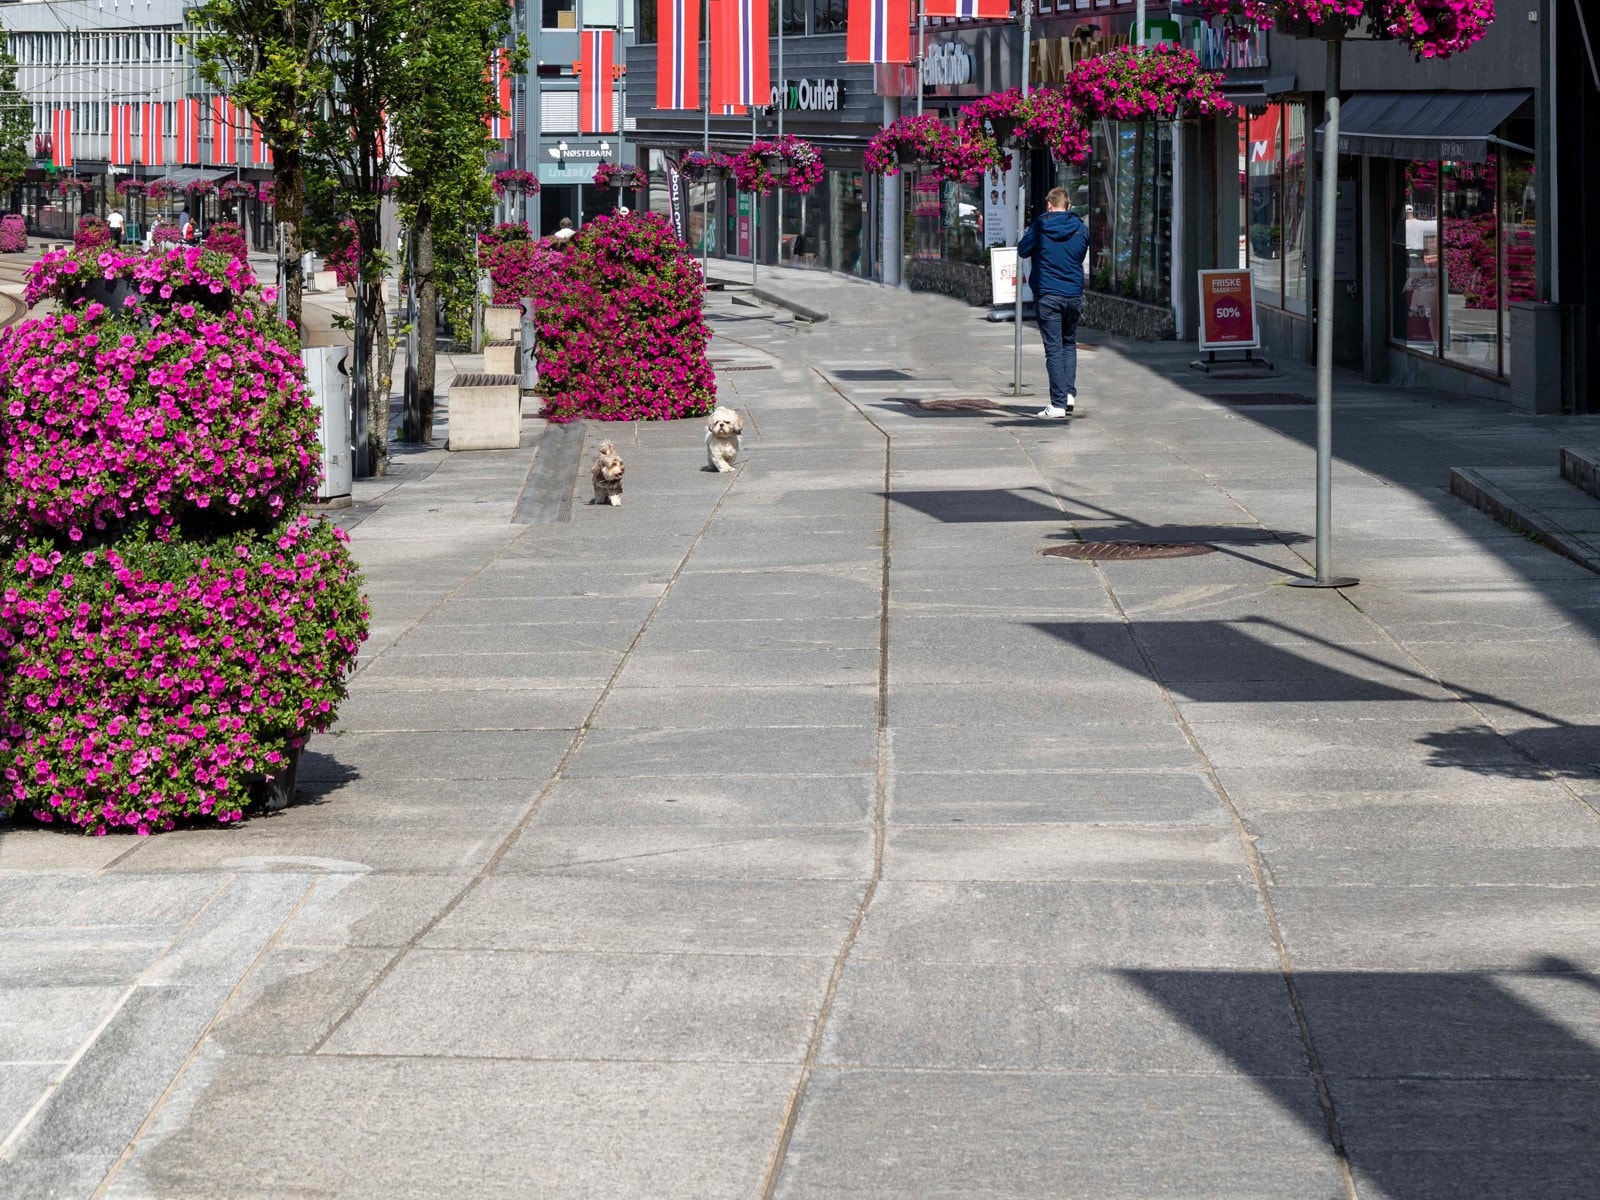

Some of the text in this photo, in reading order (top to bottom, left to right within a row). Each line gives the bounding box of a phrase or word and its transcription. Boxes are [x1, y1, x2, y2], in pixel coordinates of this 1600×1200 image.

[798, 78, 838, 110] Outlet
[563, 149, 613, 158] NØSTEBARN
[1211, 278, 1242, 288] FRISKE
[1216, 307, 1240, 318] 50%
